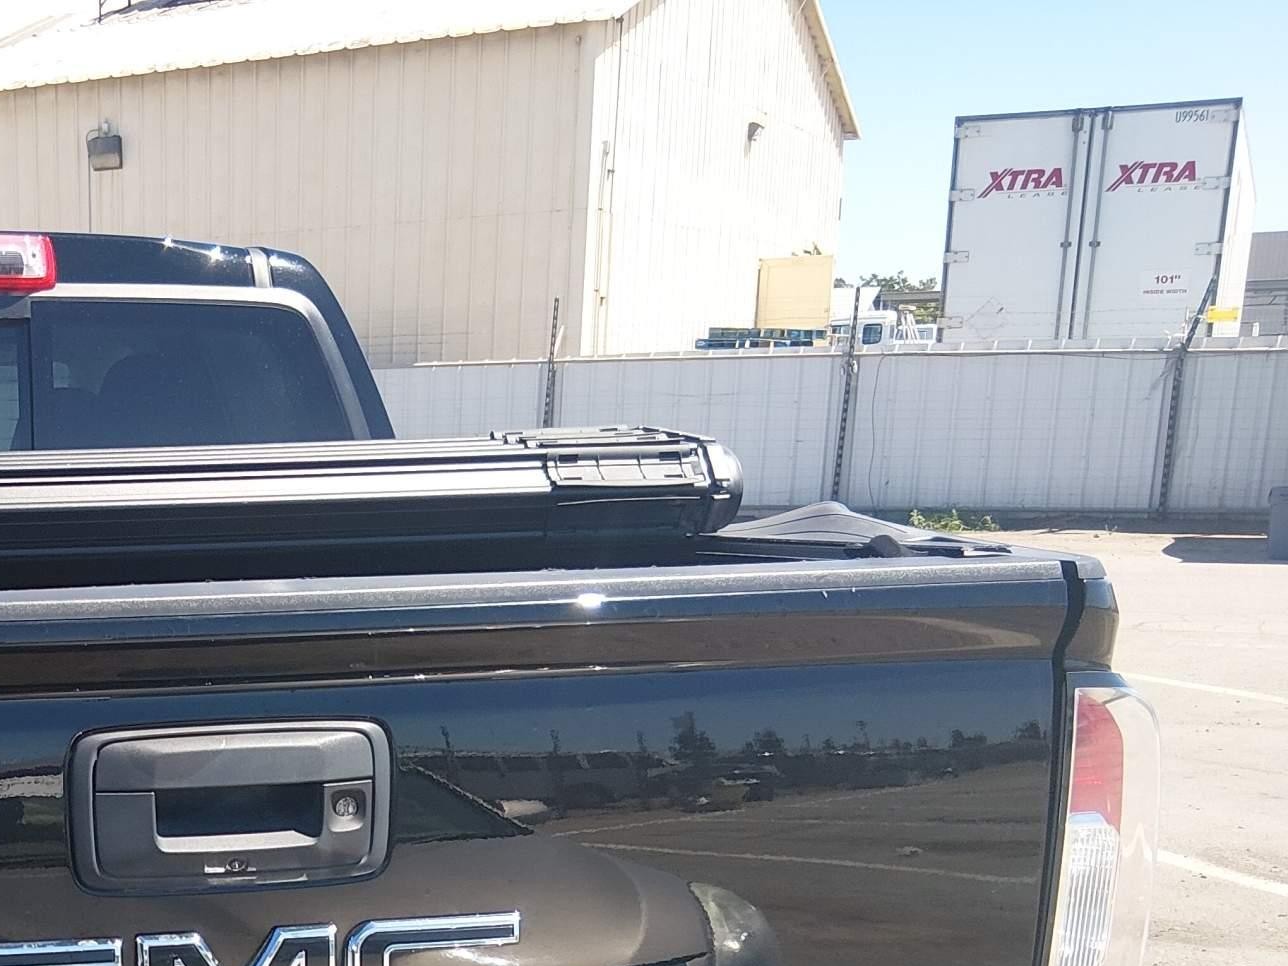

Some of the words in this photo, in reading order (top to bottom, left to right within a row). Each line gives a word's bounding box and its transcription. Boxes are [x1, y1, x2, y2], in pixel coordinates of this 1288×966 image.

[1175, 109, 1210, 123] U99561
[977, 167, 1063, 199] XTRA
[1105, 160, 1197, 192] XTRA
[1154, 274, 1181, 285] 101"
